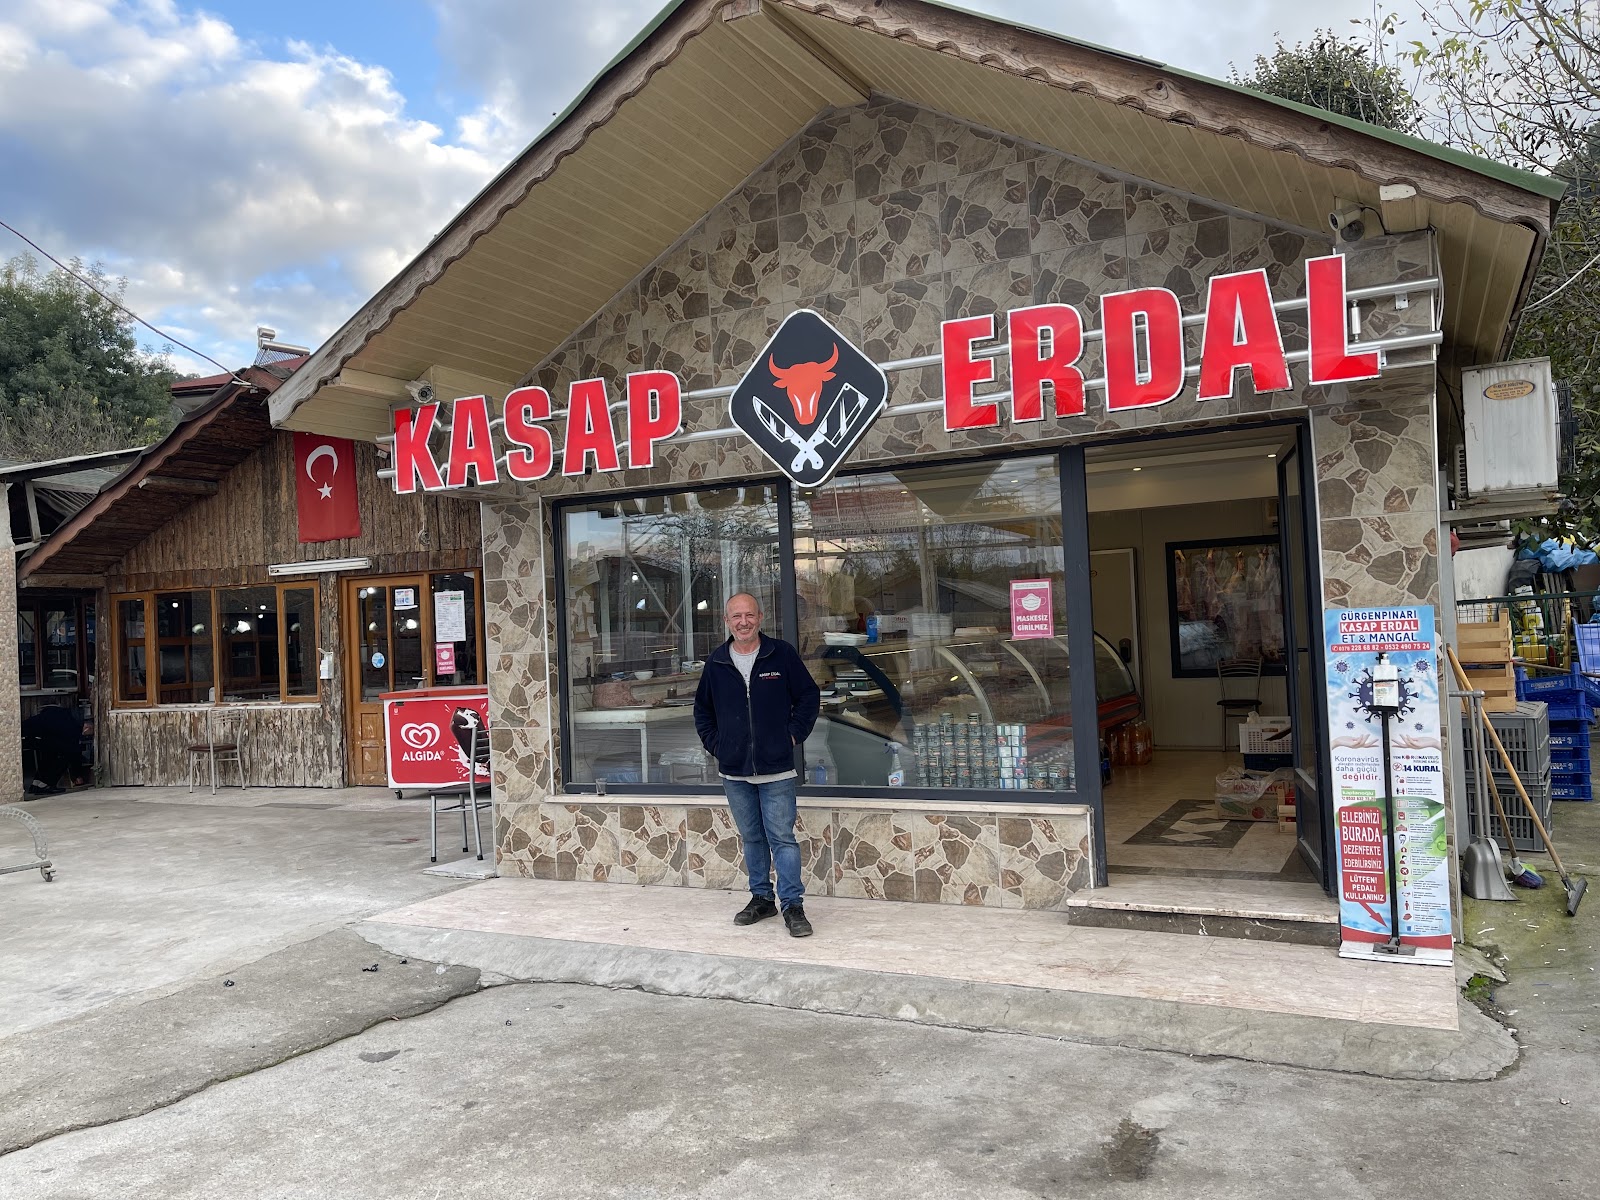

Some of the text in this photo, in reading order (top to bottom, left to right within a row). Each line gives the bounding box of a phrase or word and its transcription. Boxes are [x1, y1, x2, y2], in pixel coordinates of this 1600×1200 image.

[394, 253, 1381, 494] KASAP ERDAL
[1016, 614, 1048, 622] MASKESİZ
[1341, 610, 1416, 620] GÜRGENPINARI
[1017, 622, 1048, 631] GİRİLMEZ
[1341, 620, 1417, 632] KASAP ERDAL
[1342, 632, 1418, 643] ET & MANGAL
[1342, 809, 1380, 824] ELLERİNİZİ
[1342, 826, 1381, 842] BURADA
[1344, 845, 1381, 856] DEZENFEKTE
[1344, 857, 1382, 869] EDEBİLİRSİNİZ
[1352, 884, 1376, 892] PEDALI
[1345, 892, 1384, 901] KULLANINIZ
